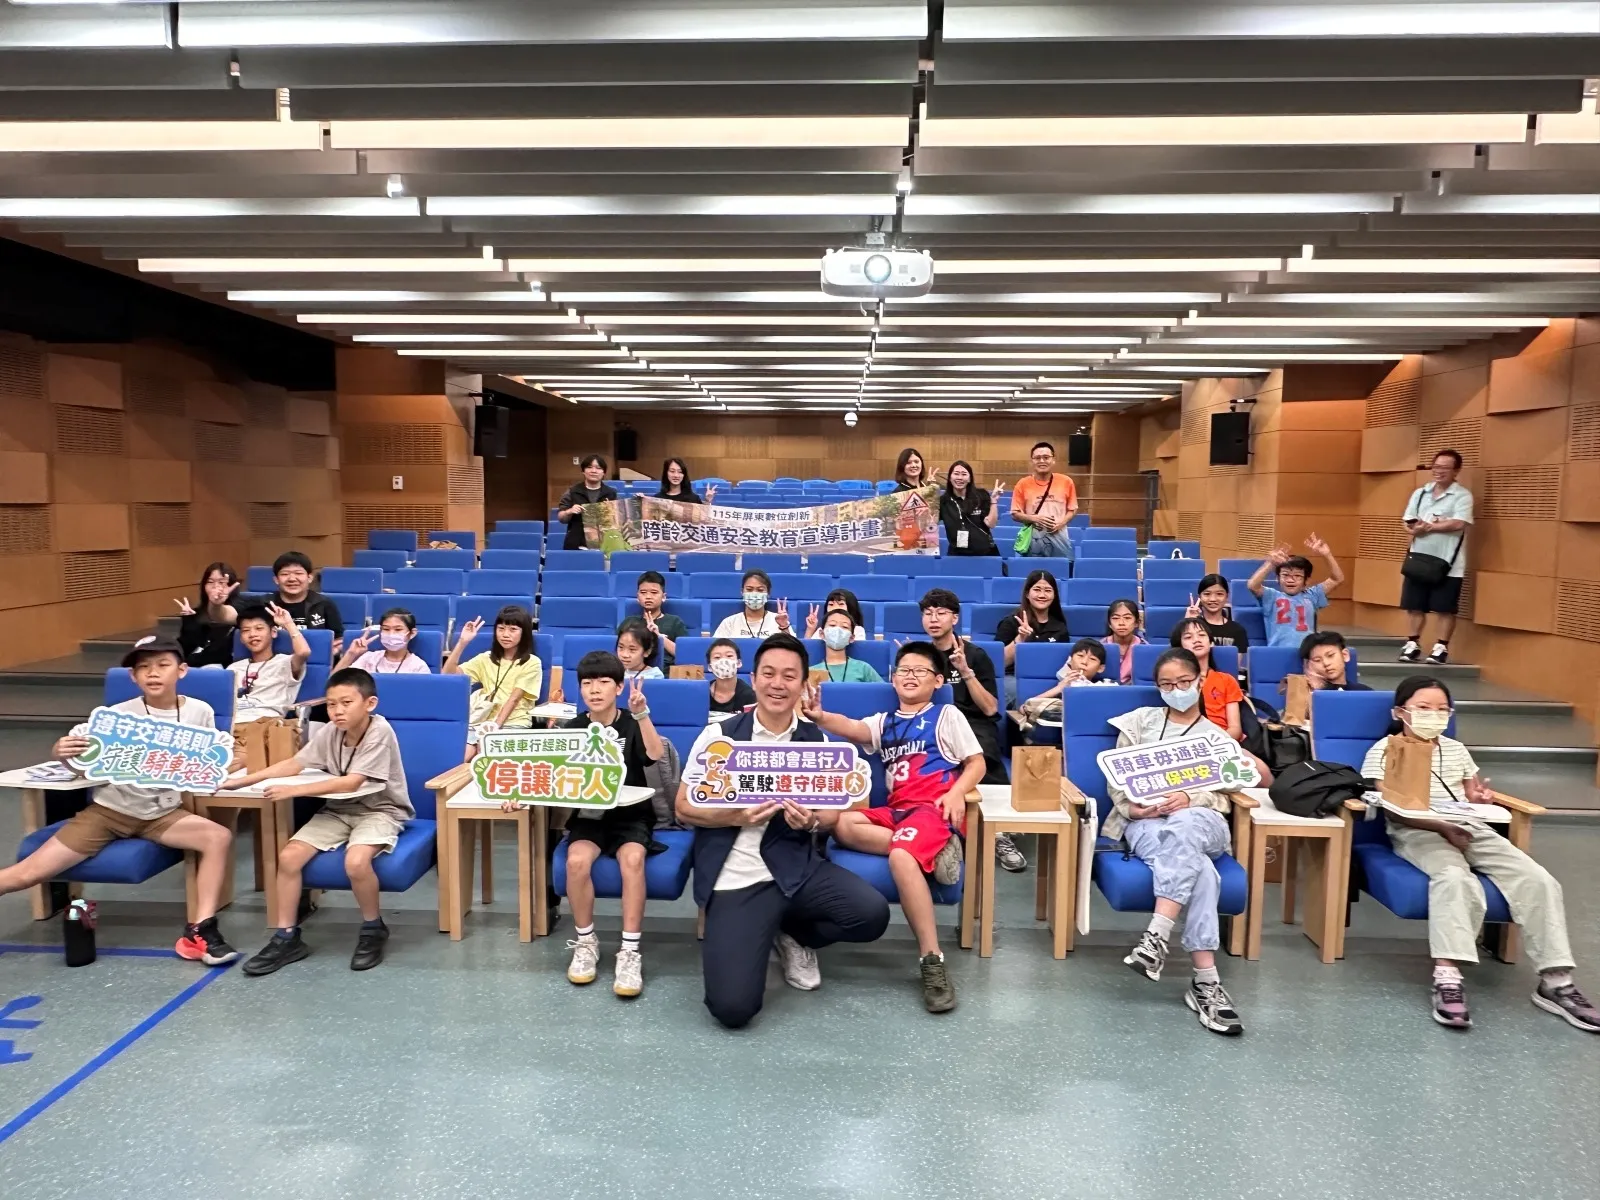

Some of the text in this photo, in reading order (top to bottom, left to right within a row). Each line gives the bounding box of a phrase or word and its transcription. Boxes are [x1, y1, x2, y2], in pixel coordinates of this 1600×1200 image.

[712, 510, 810, 521] 115年屏東數位創新
[643, 519, 880, 547] 跨齡交通安全教育宣導計畫
[1276, 598, 1308, 632] 21
[92, 714, 214, 753] 遵守交通規則
[490, 738, 580, 753] 汽機車行經路口
[102, 742, 221, 786] 守護騎車安全
[735, 750, 850, 769] 你我都會是行人
[486, 760, 612, 801] 停讓行人
[738, 774, 844, 793] 駕駛遵守停讓
[1132, 764, 1212, 794] 停讓保平安
